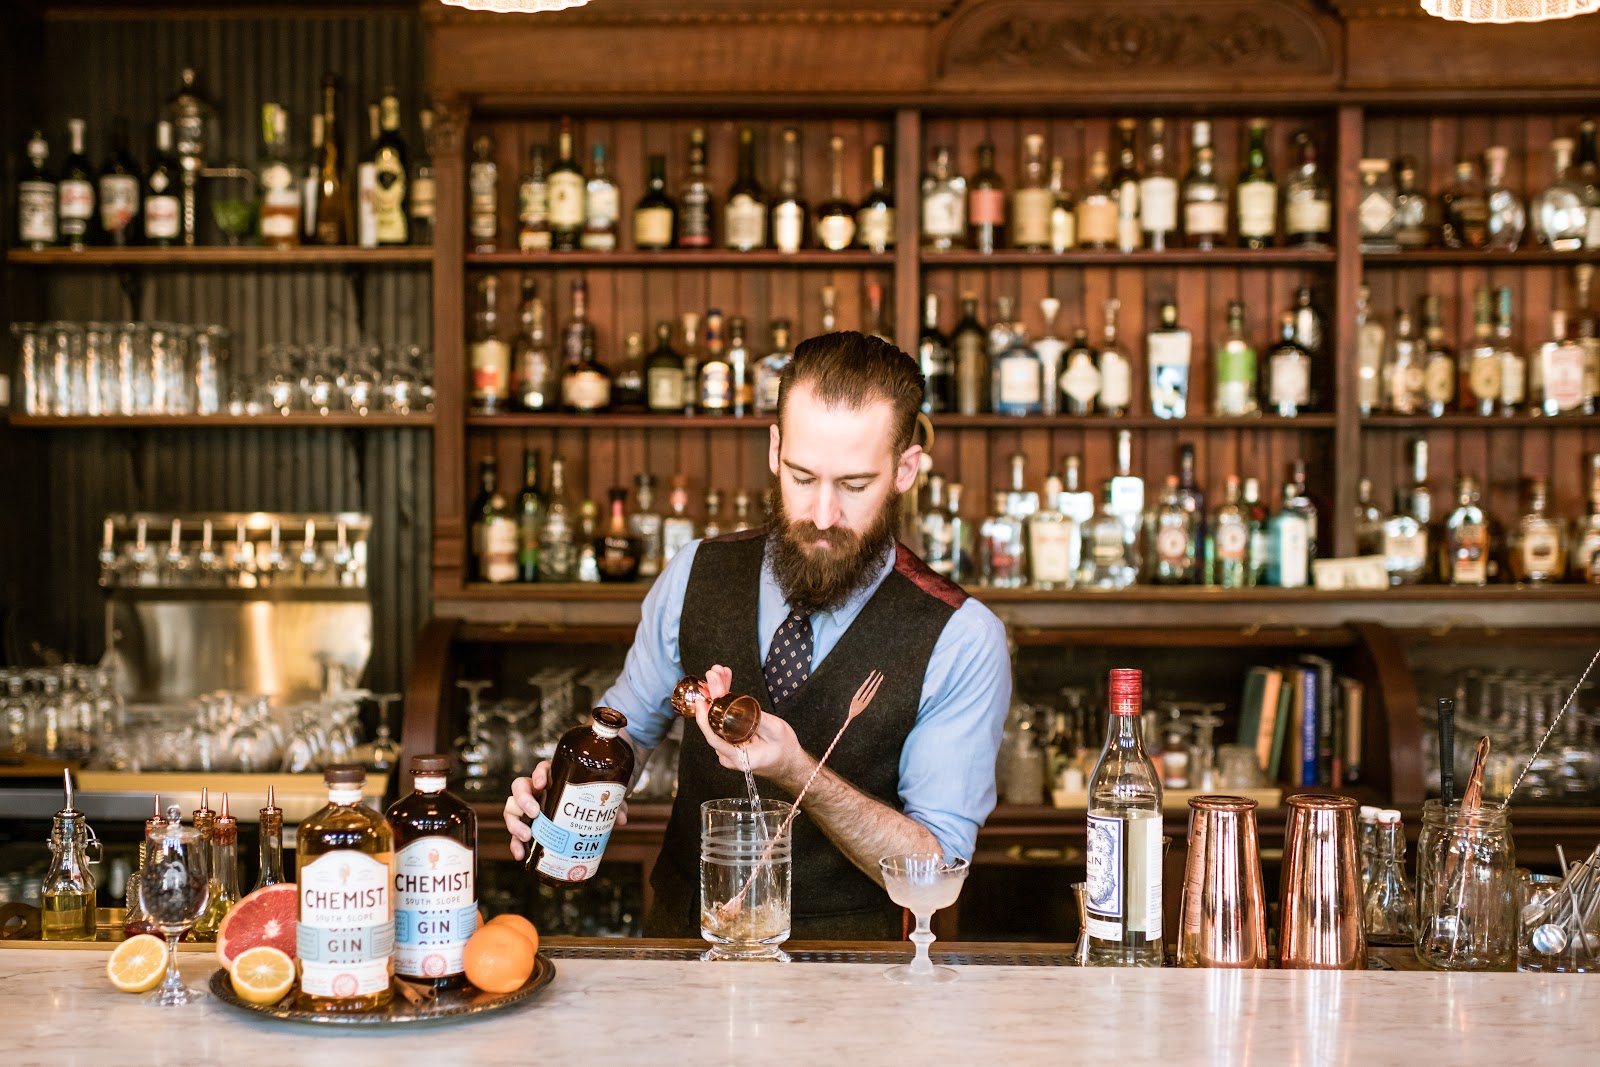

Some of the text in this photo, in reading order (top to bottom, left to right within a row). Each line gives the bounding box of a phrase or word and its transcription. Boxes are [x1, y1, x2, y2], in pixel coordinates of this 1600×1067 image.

[570, 821, 592, 831] SOUTH
[574, 841, 600, 852] GIN
[395, 871, 470, 893] CHEMIST
[305, 887, 385, 910] CHEMIST
[405, 896, 460, 906] SOUTH SLOPE
[315, 913, 373, 922] SOUTH SLOPE
[417, 920, 450, 935] GIN
[328, 938, 362, 953] GIN
